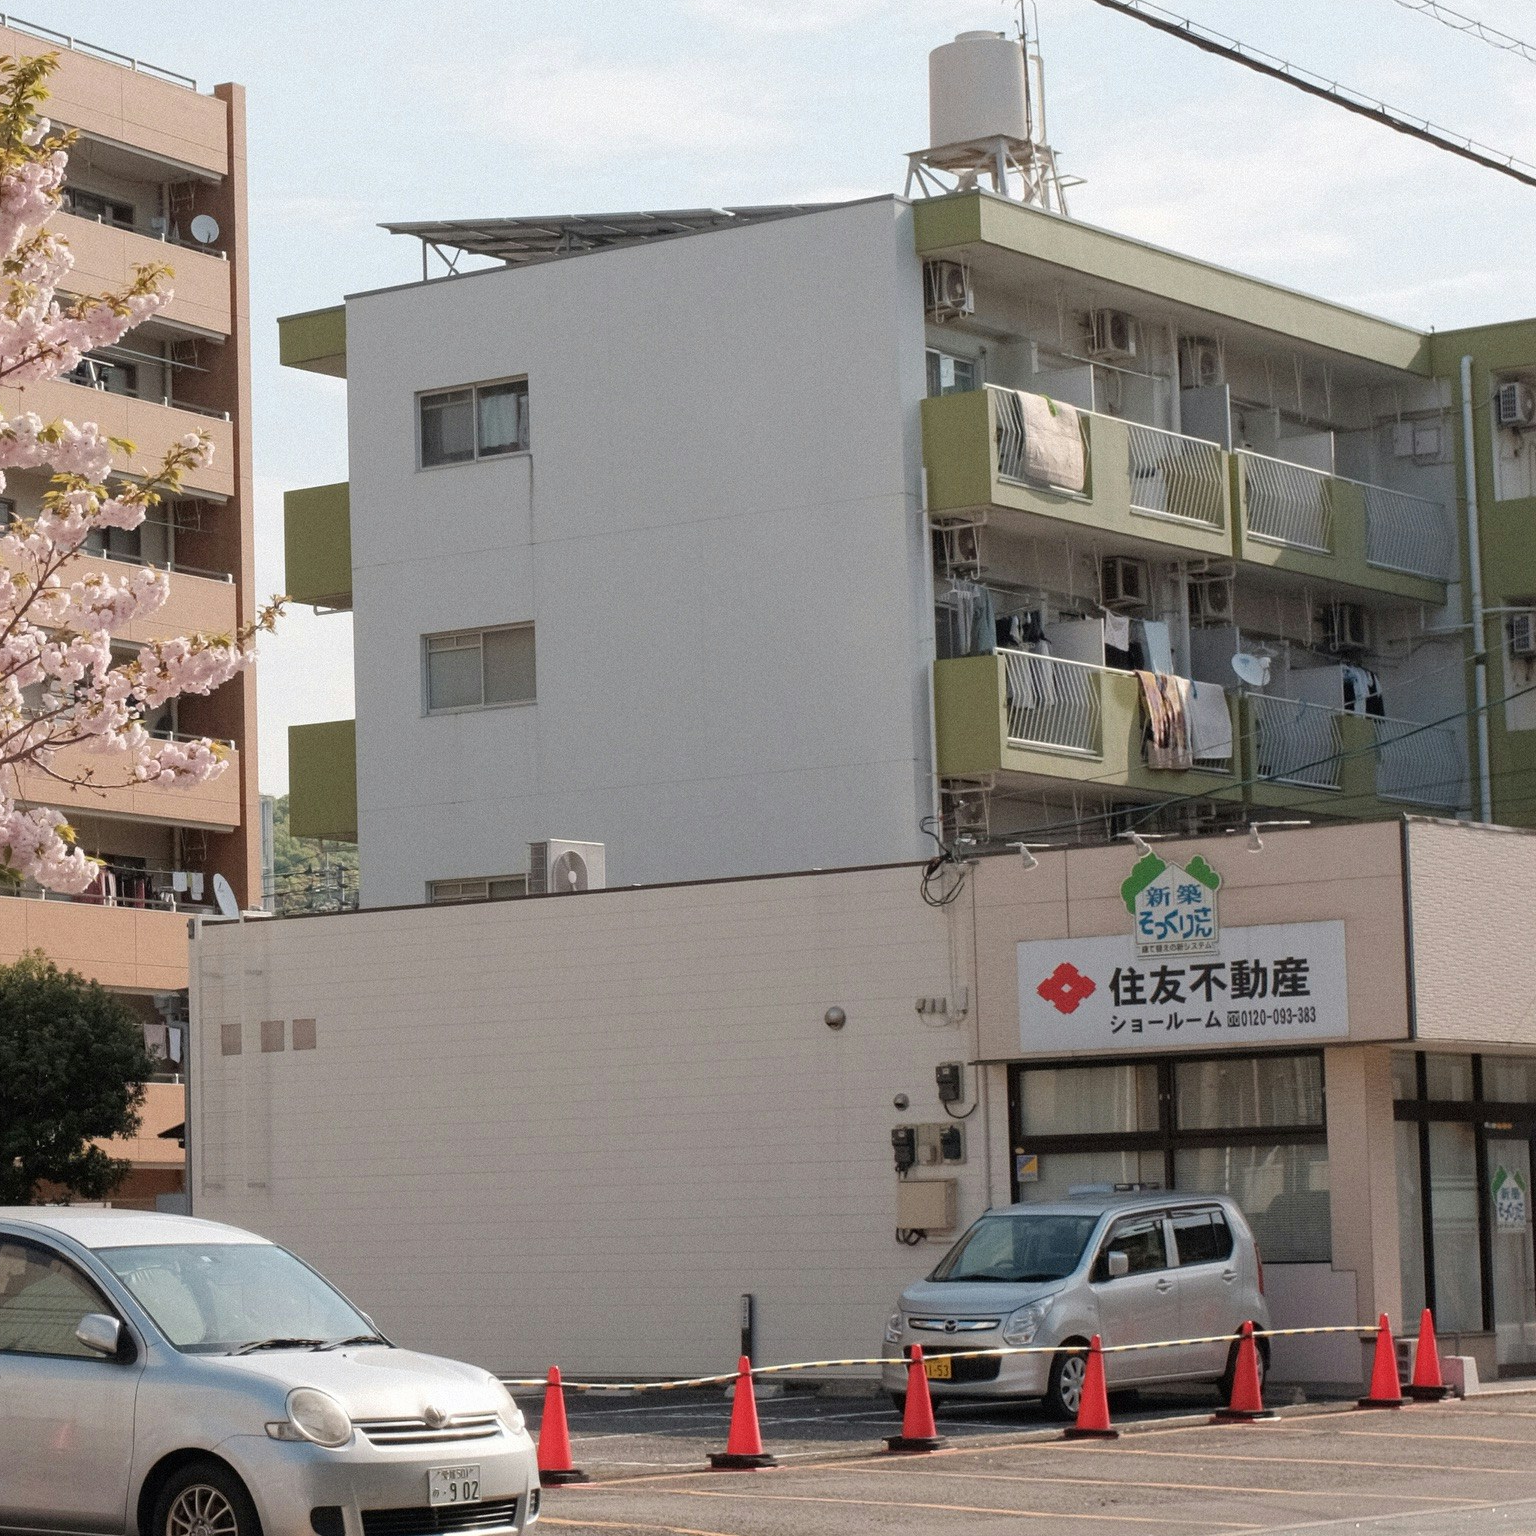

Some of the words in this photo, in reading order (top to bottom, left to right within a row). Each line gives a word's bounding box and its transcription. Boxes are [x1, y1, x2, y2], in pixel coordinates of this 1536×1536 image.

[1146, 884, 1202, 907] 新築
[1109, 956, 1311, 1007] 住友不動産
[1110, 1011, 1222, 1034] ショールーム
[1241, 1006, 1317, 1027] 0120-093-383
